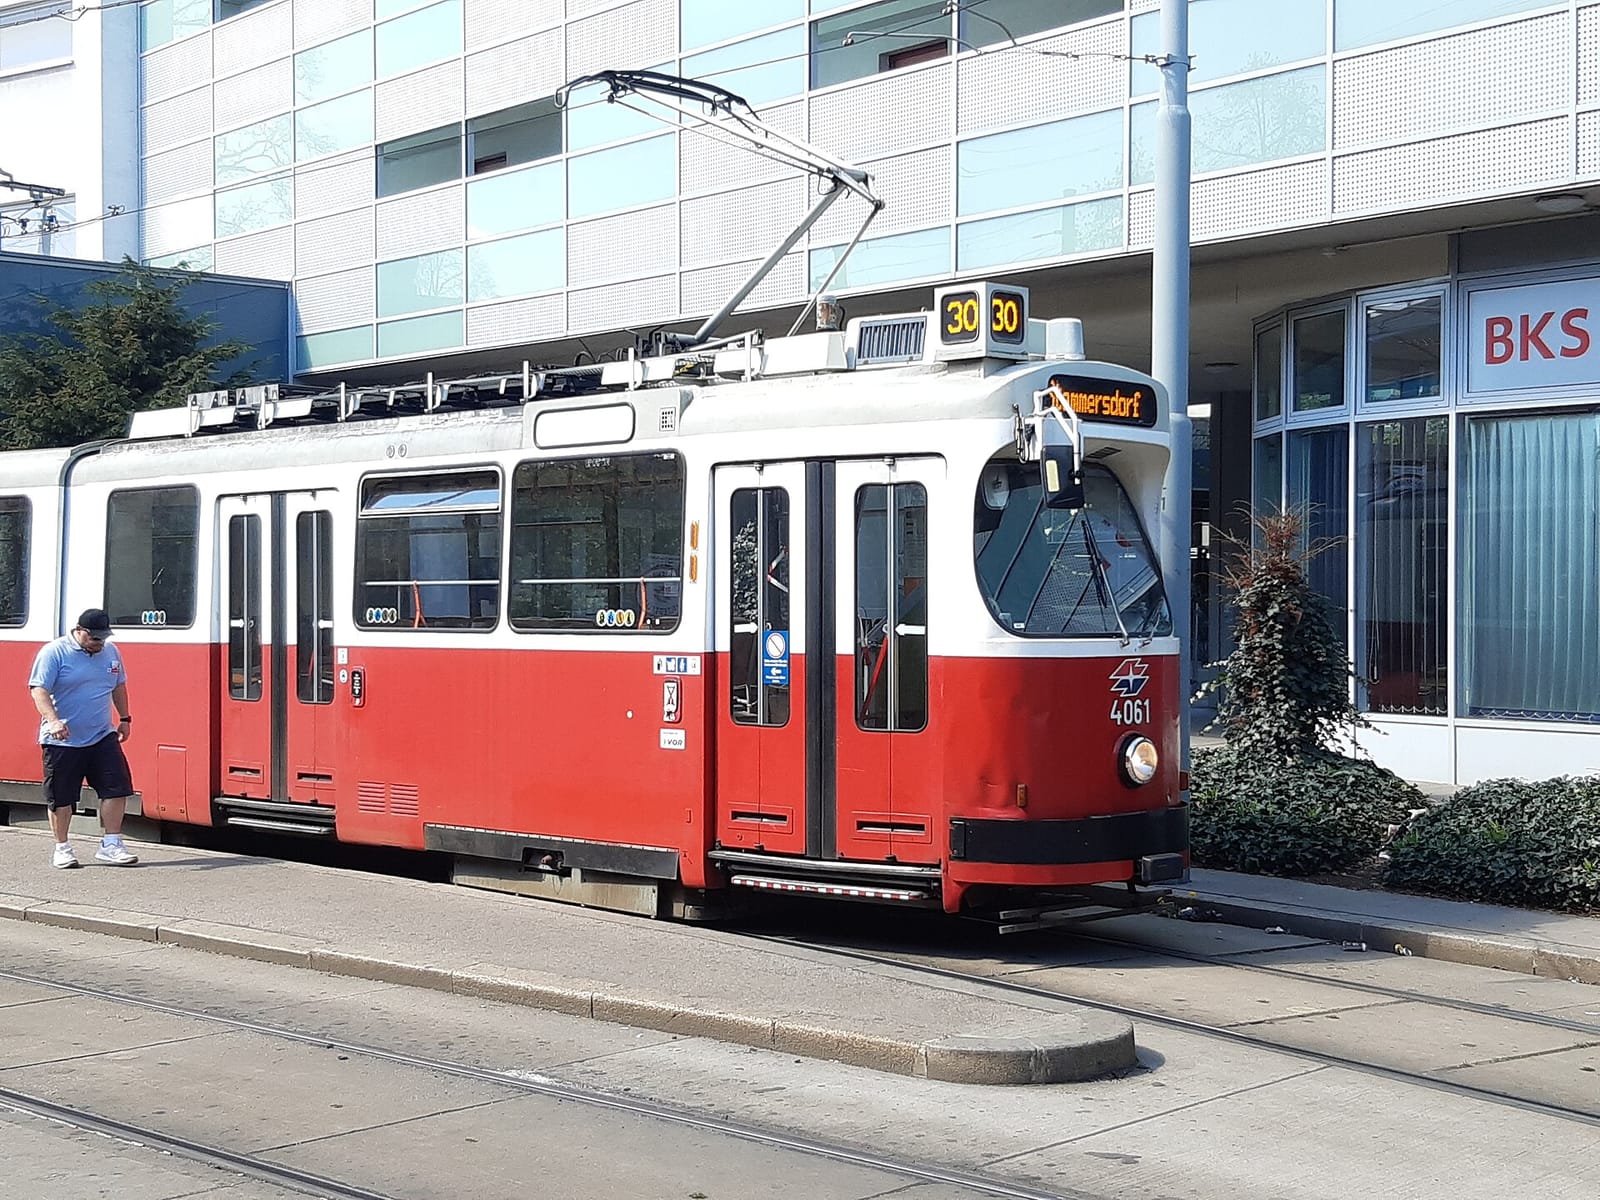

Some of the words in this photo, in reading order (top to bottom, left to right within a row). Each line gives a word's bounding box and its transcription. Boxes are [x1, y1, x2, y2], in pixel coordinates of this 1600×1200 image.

[947, 299, 978, 334] 30
[992, 298, 1018, 333] 30
[1485, 307, 1591, 365] BKS
[1110, 699, 1151, 726] 4061
